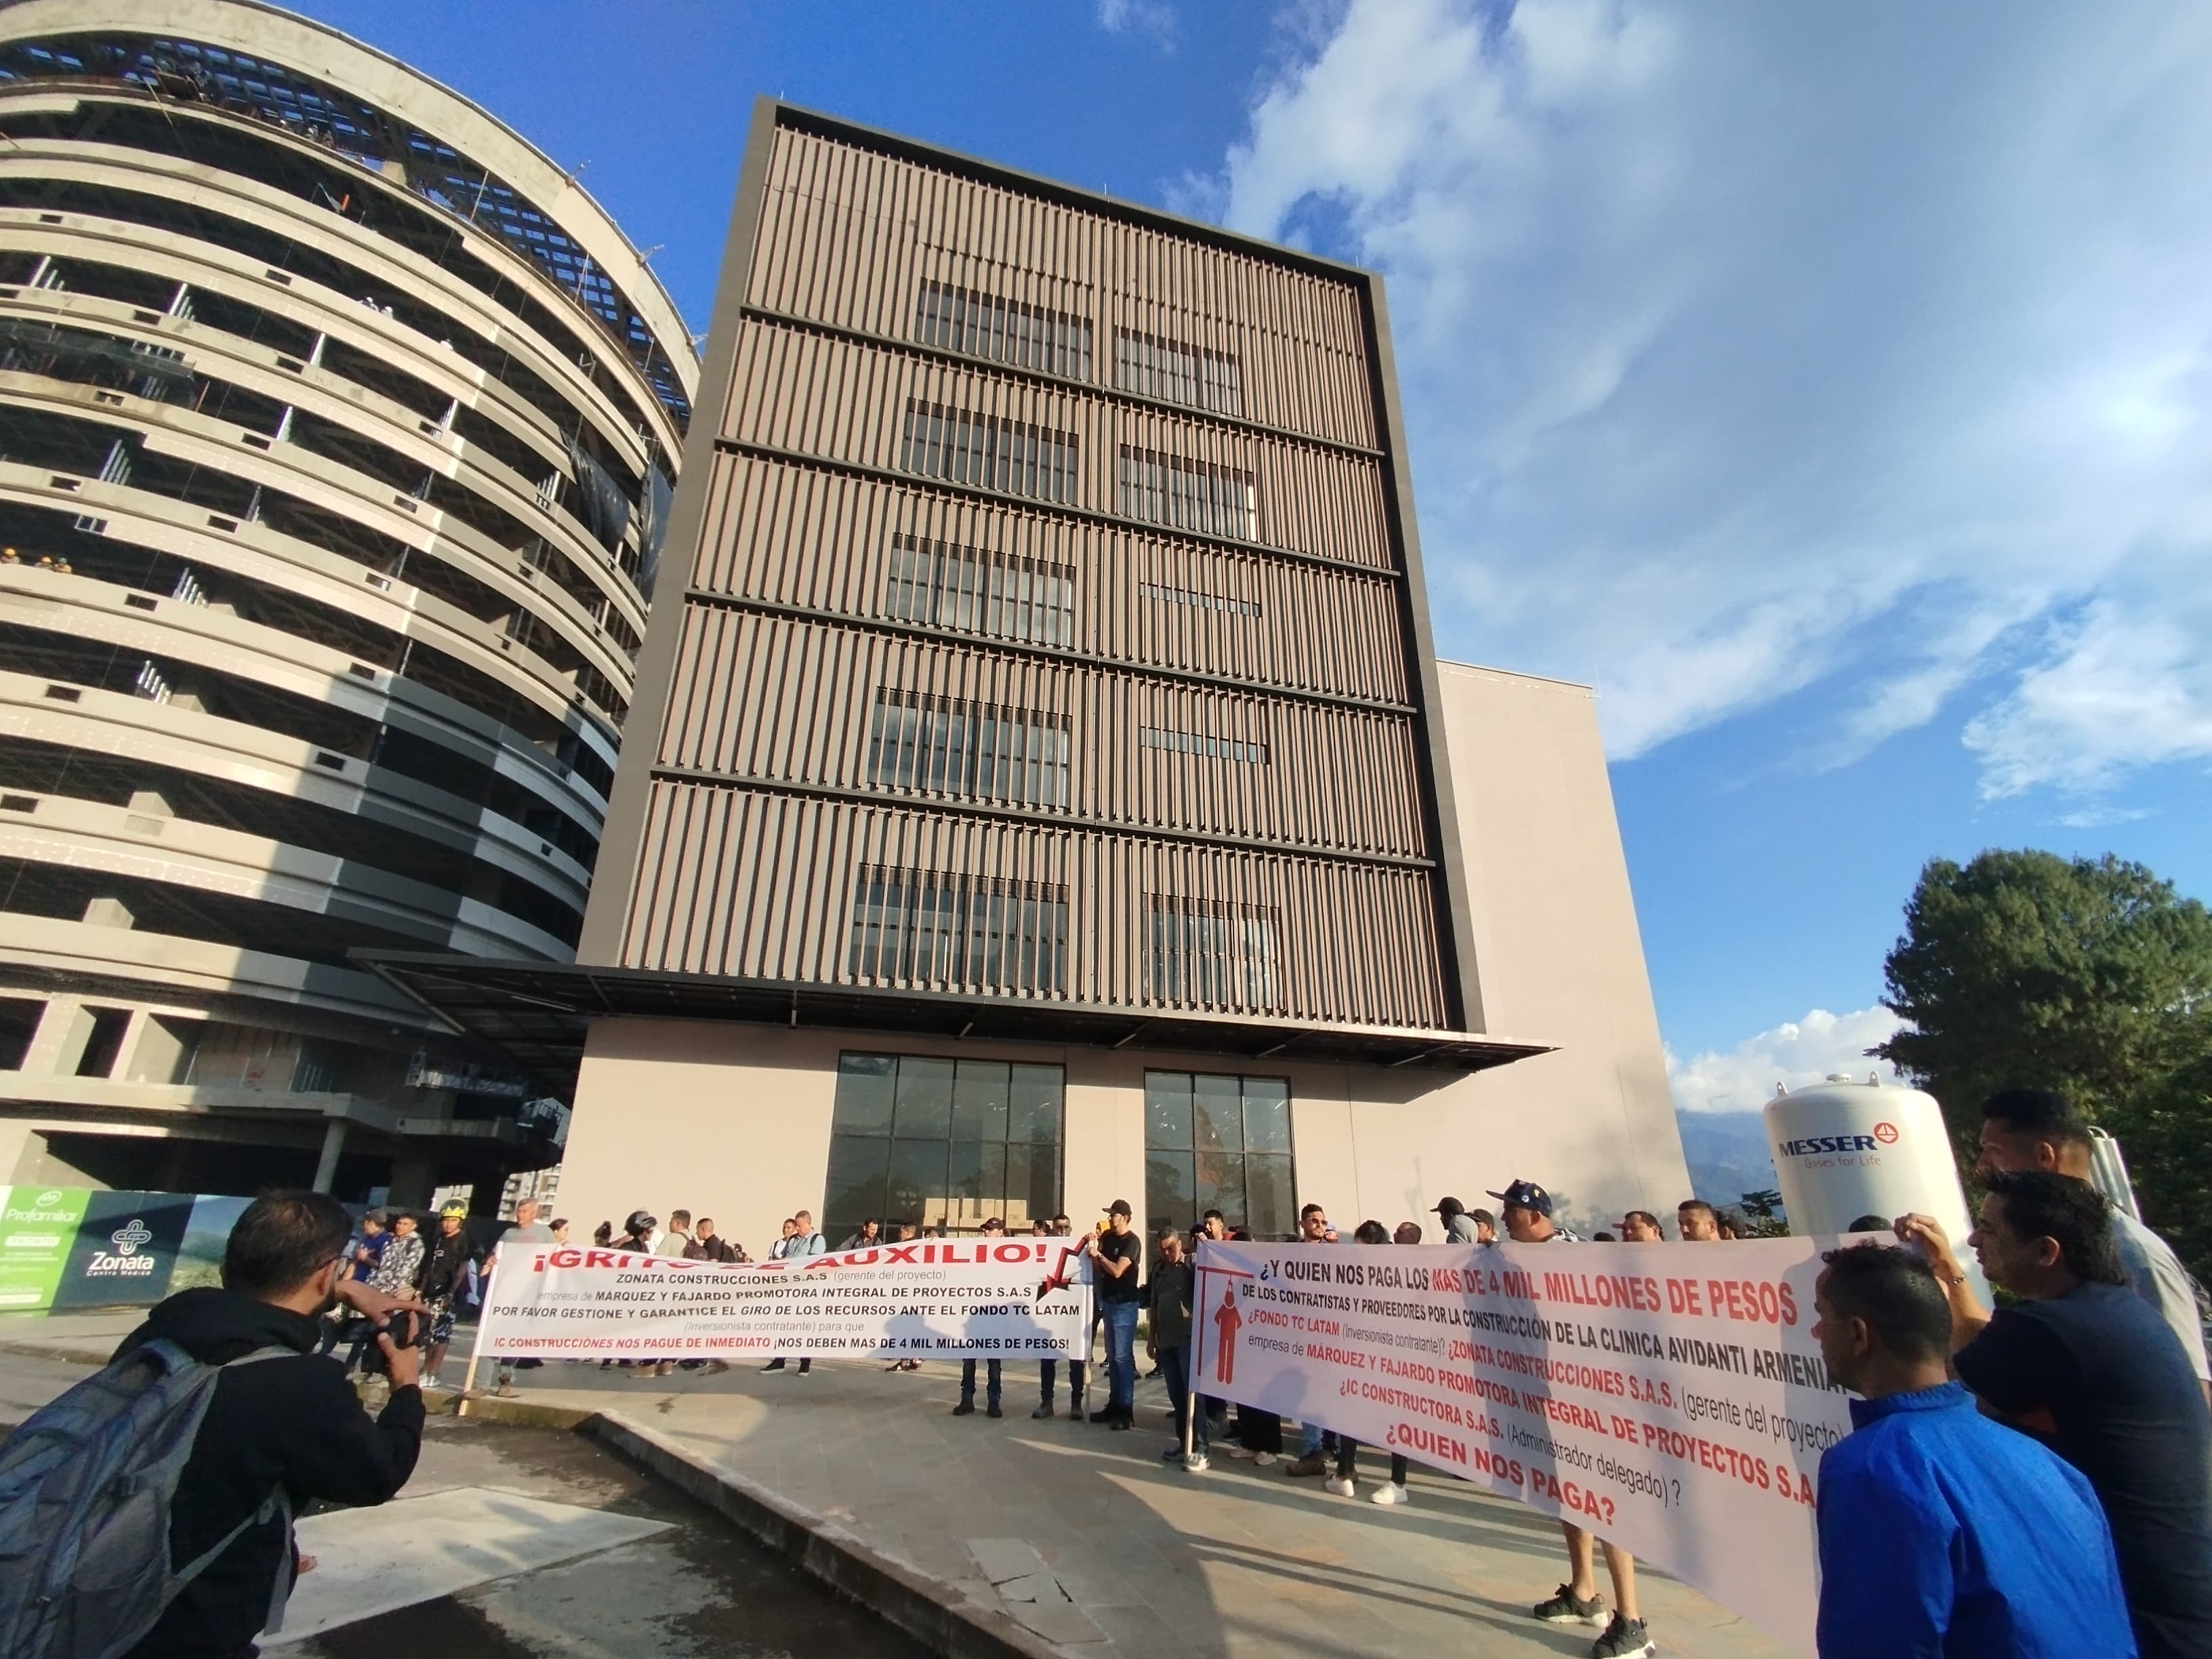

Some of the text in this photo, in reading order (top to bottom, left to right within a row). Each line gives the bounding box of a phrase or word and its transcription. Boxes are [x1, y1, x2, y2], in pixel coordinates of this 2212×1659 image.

[1779, 1135, 1878, 1158] MESSER
[1804, 1155, 1882, 1170] Gases for Life
[89, 1251, 155, 1270] Zonata
[803, 1244, 1047, 1270] AUXILIO!
[616, 1274, 664, 1284] ZONATA
[669, 1274, 788, 1284] CONSTRUCCIONES
[834, 1271, 876, 1283] (gerente
[879, 1270, 894, 1279] del
[897, 1270, 946, 1282] proyecto)
[537, 1287, 1031, 1302] empresa de MÁRQUEZ Y FAJARDO PROMOTORA INTEGRAL DE PROYECTOS S.A.S
[1261, 1259, 1798, 1326] ¿Y QUIEN NOS PAGA LOS MAS DE 4 MIL MILLONES DE PESOS
[493, 1305, 1080, 1319] POR FAVOR GESTIONE Y GARANTICE EL GIRO DE LOS RECURSOS ANTE EL FONDO TC LATAM
[684, 1321, 864, 1332] (Inversionista contratante) para que
[1242, 1284, 1255, 1297] DE
[1258, 1286, 1277, 1301] LOS
[1279, 1289, 1350, 1311] CONTRATISTAS
[1353, 1298, 1359, 1312] Y
[1362, 1298, 1426, 1322] PROVEEDORES
[1429, 1305, 1447, 1324] POR
[1449, 1307, 1460, 1327] LA
[1463, 1309, 1551, 1341] CONSTRUCCIÓN
[1555, 1322, 1574, 1345] DE
[1577, 1324, 1598, 1349] LA
[1601, 1326, 1664, 1359] CLINICA
[1668, 1336, 1747, 1375] AVIDANTI
[494, 1338, 506, 1347] IC
[616, 1338, 640, 1348] NOS
[644, 1338, 682, 1348] PAGUE
[687, 1338, 701, 1347] DE
[705, 1337, 771, 1347] INMEDIATO
[774, 1338, 802, 1349] ¡NOS
[806, 1338, 846, 1347] DEBEN
[851, 1338, 876, 1348] MAS
[880, 1338, 896, 1348] DE
[900, 1338, 907, 1348] 4
[911, 1338, 933, 1349] MIL
[937, 1338, 1000, 1349] MILLONES
[1004, 1338, 1021, 1349] DE
[1025, 1338, 1069, 1349] PESOS!
[1248, 1309, 1288, 1328] ¿FONDO
[1292, 1315, 1304, 1330] TC
[1307, 1317, 1339, 1336] LATAM
[1343, 1323, 1393, 1346] (Inversionista
[1395, 1331, 1446, 1358] contratante)?
[1448, 1340, 1496, 1366] ¿ZONATA
[1497, 1348, 1625, 1401] CONSTRUCCIONES
[1629, 1375, 1678, 1410] S.A.S.
[1682, 1386, 1740, 1427] (gerente
[1745, 1405, 1767, 1435] del
[1248, 1334, 1289, 1353] empresa
[1292, 1341, 1304, 1356] de
[1307, 1343, 1366, 1369] MÁRQUEZ
[1369, 1355, 1376, 1370] Y
[1380, 1357, 1435, 1384] FAJARDO
[1438, 1369, 1520, 1410] PROMOTORA
[1523, 1391, 1609, 1435] INTEGRAL
[1610, 1414, 1639, 1444] DE
[1642, 1423, 1769, 1490] PROYECTOS
[1340, 1378, 1358, 1396] ¿IC
[1361, 1382, 1462, 1426] CONSTRUCTORA
[1466, 1409, 1504, 1439] S.A.S.
[1507, 1422, 1593, 1472] (Administrador
[1597, 1454, 1668, 1508] delegado)
[1387, 1423, 1616, 1525] ¿QUIEN NOS PAGA?
